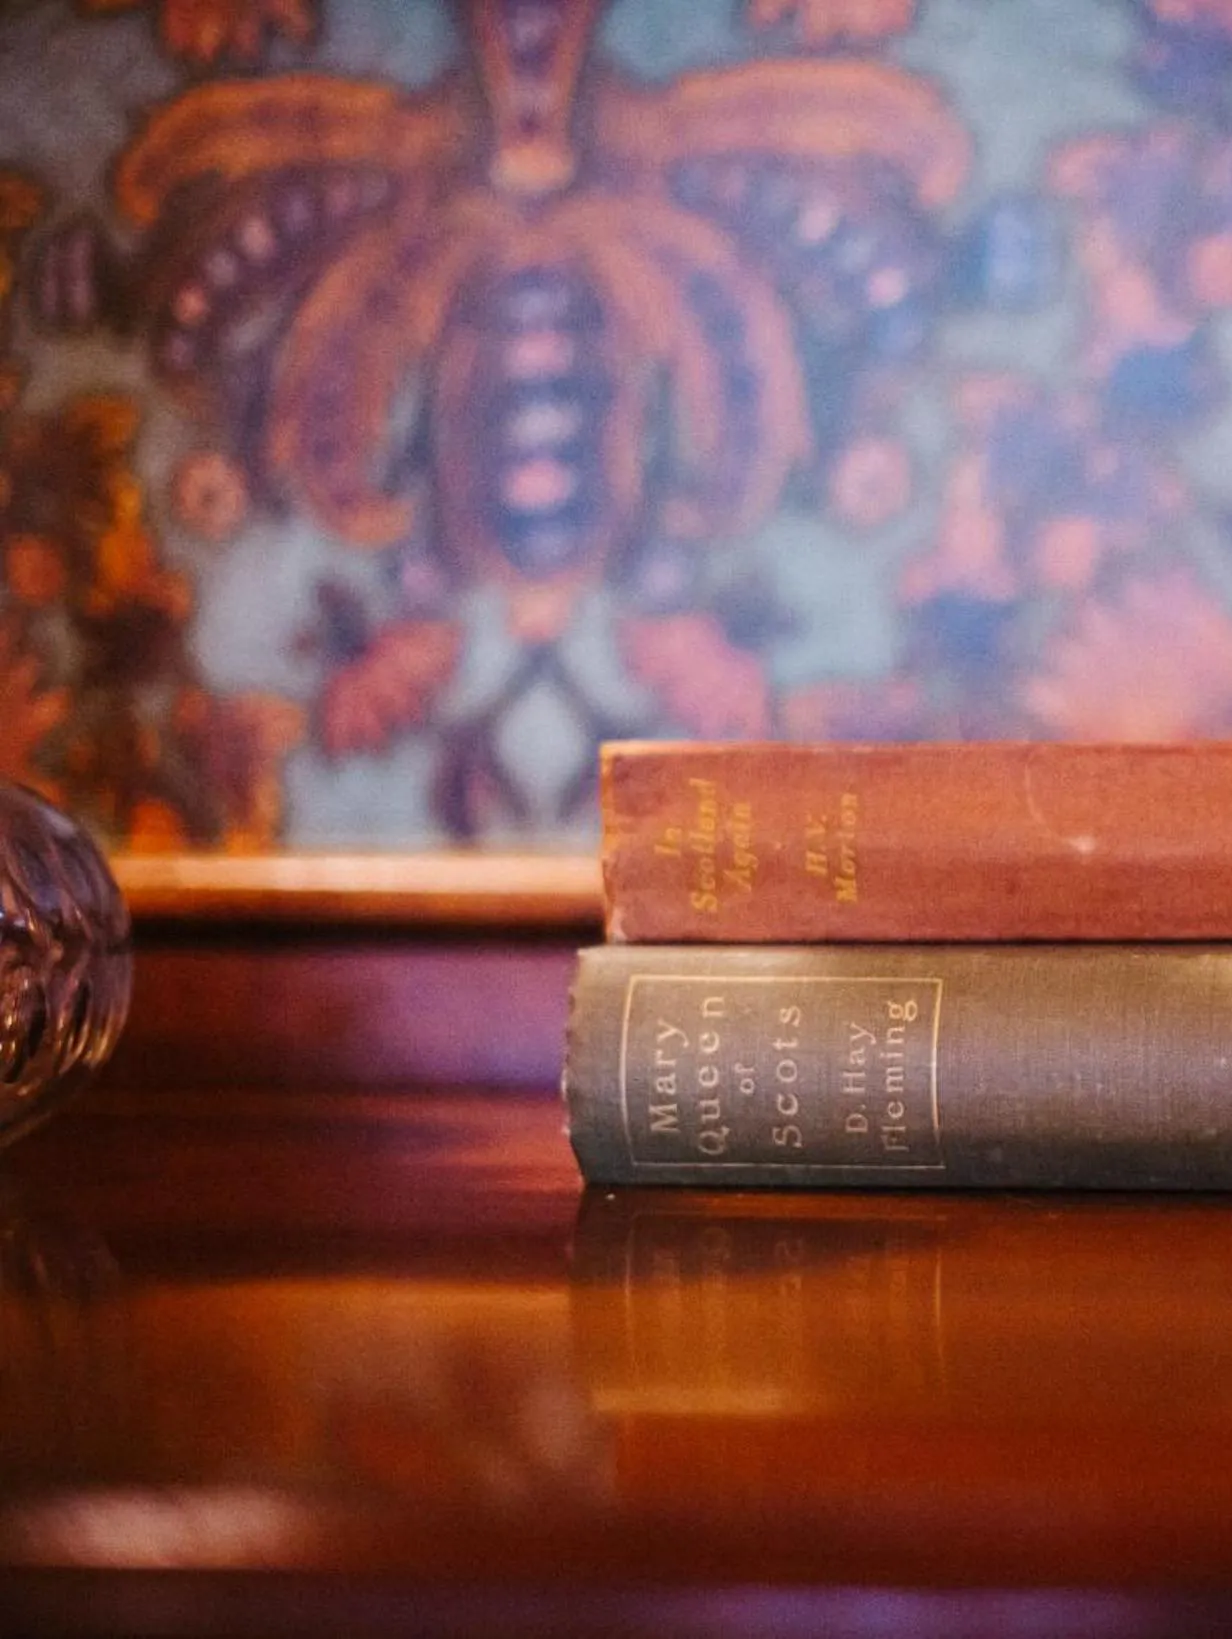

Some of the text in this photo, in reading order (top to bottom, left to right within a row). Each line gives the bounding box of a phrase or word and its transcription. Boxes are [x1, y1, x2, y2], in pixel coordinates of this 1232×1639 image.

[654, 828, 682, 857] In
[688, 777, 718, 914] Scotland
[723, 801, 758, 892] Again
[835, 792, 858, 904] Morton
[649, 1018, 690, 1134] Mary
[698, 994, 732, 1156] Queen
[733, 1061, 756, 1095] of
[771, 1005, 803, 1149] Scots
[842, 1021, 877, 1133] D. Hay
[881, 998, 919, 1152] Fleming
